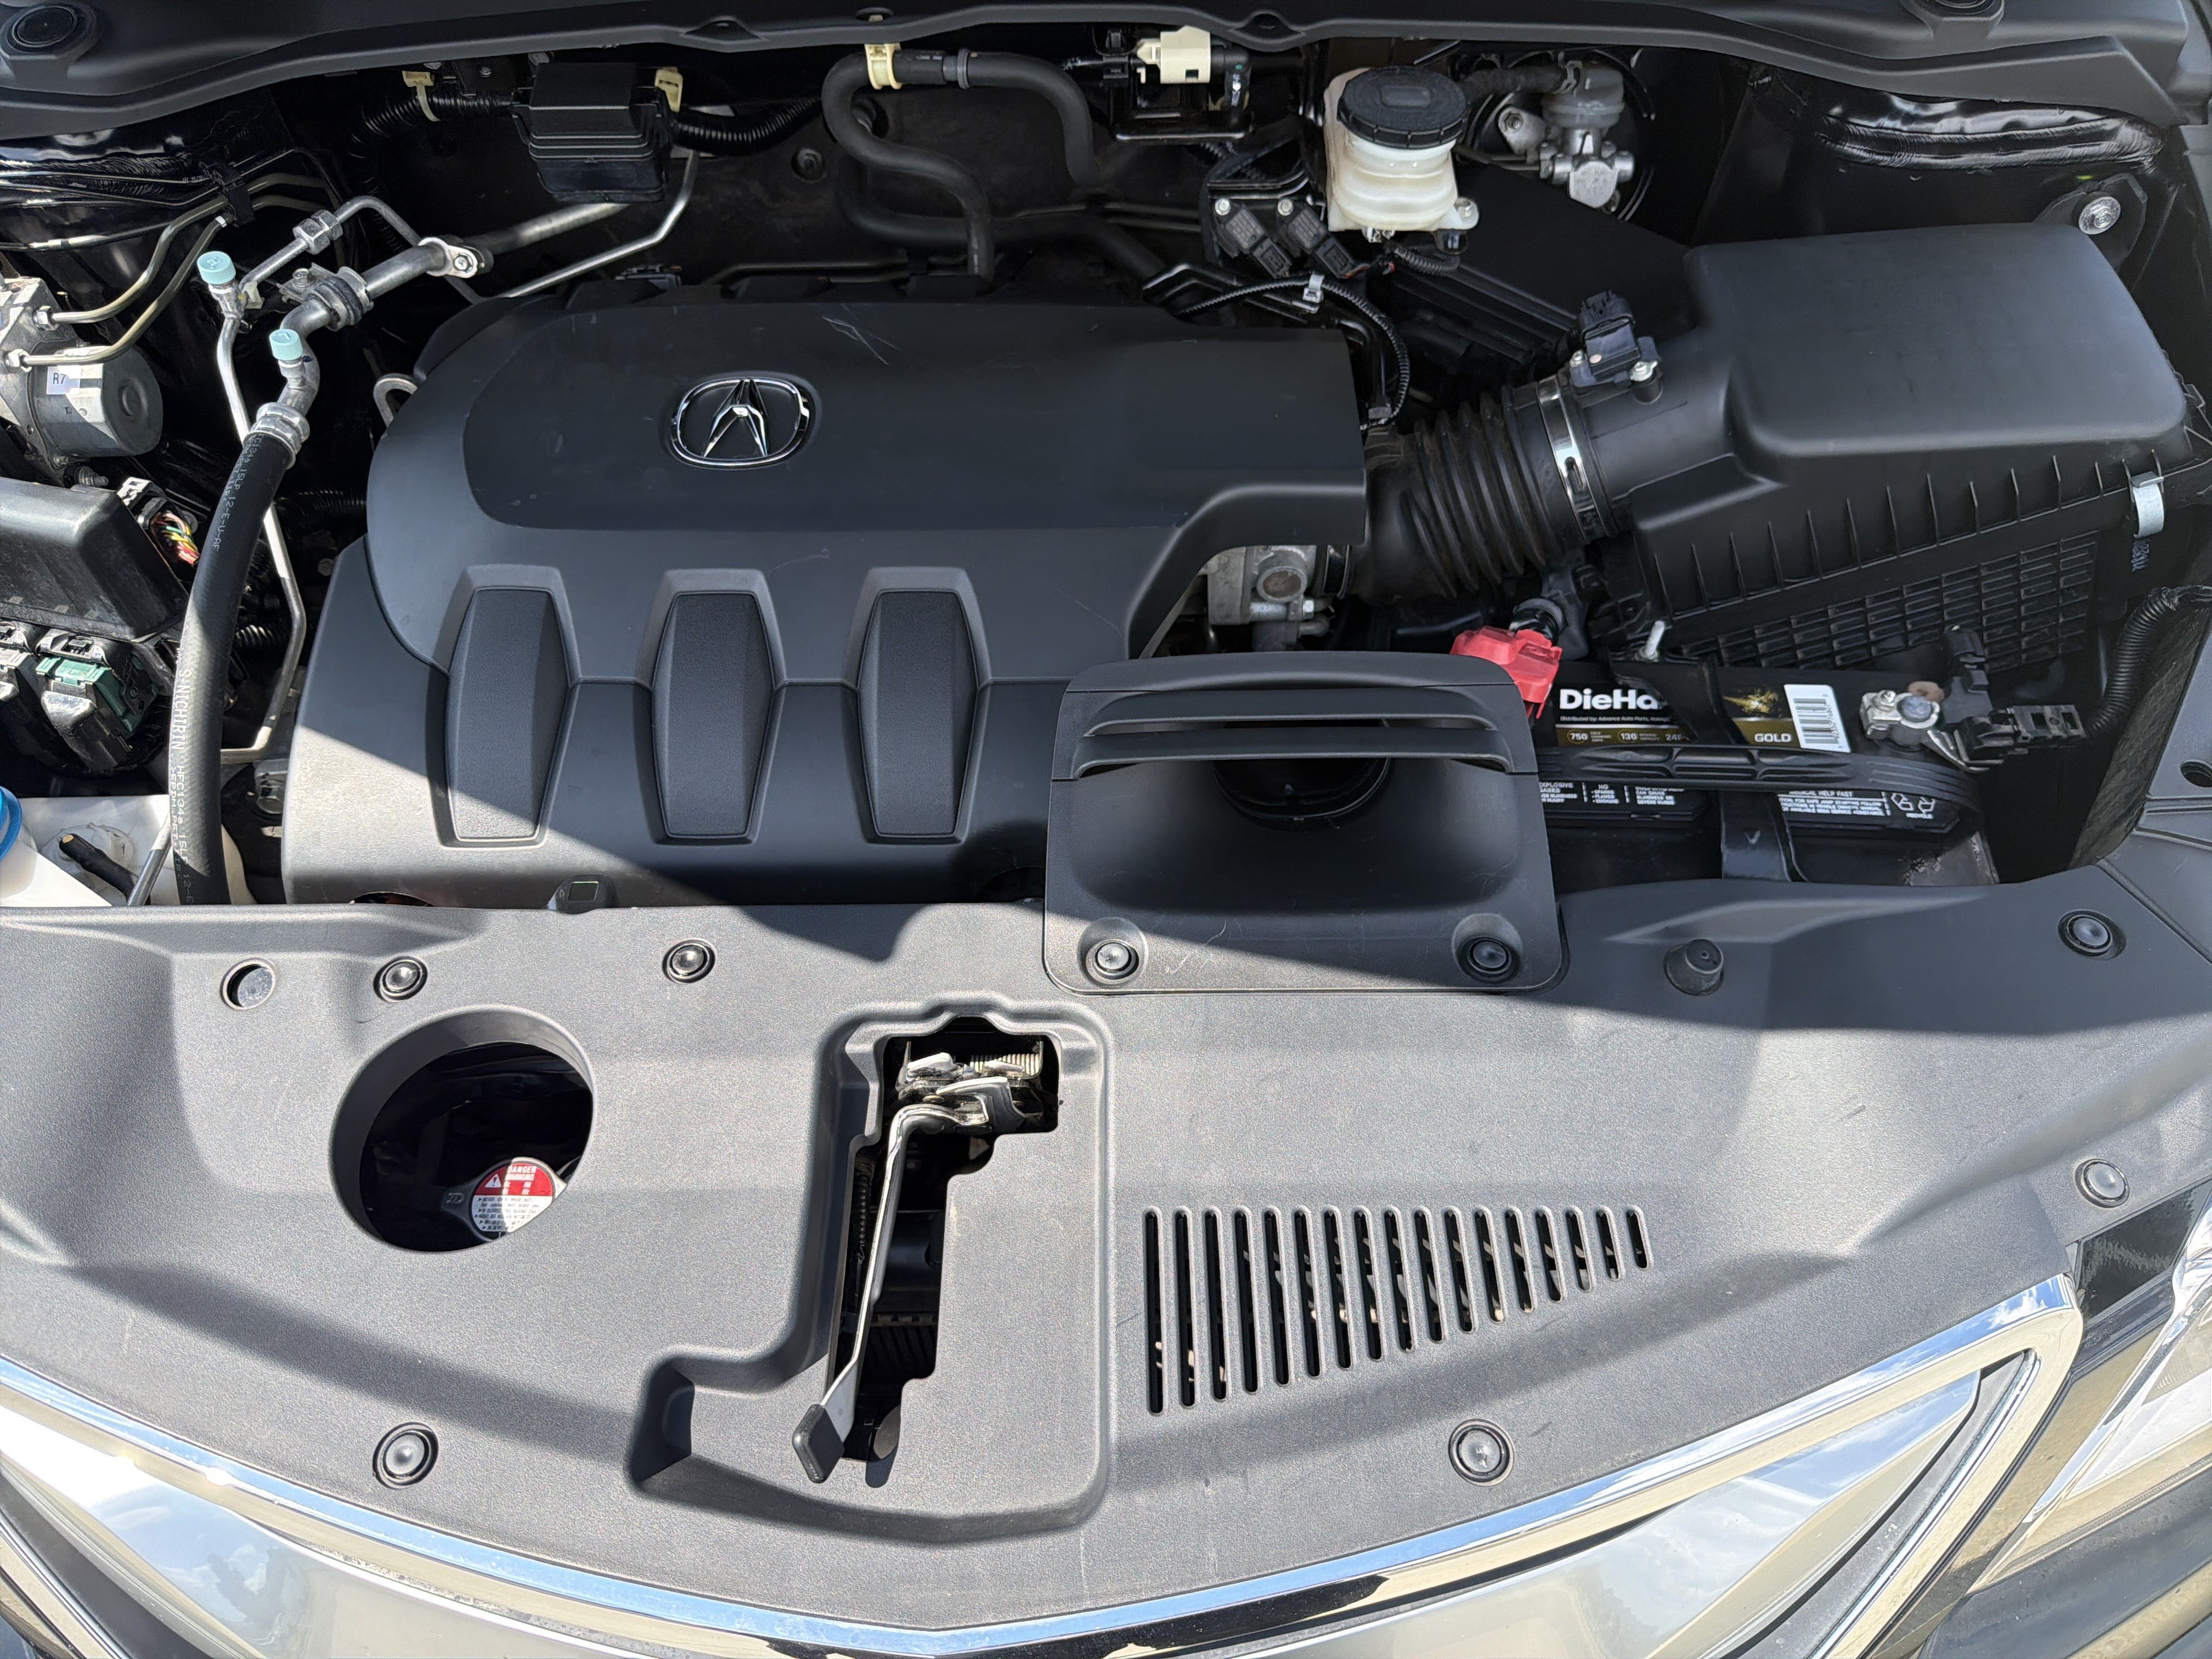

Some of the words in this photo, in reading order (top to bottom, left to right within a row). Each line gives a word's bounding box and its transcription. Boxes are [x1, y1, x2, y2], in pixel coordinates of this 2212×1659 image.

[1559, 688, 1663, 710] DieHa
[1570, 732, 1588, 741] 750
[1754, 733, 1791, 742] GOLD
